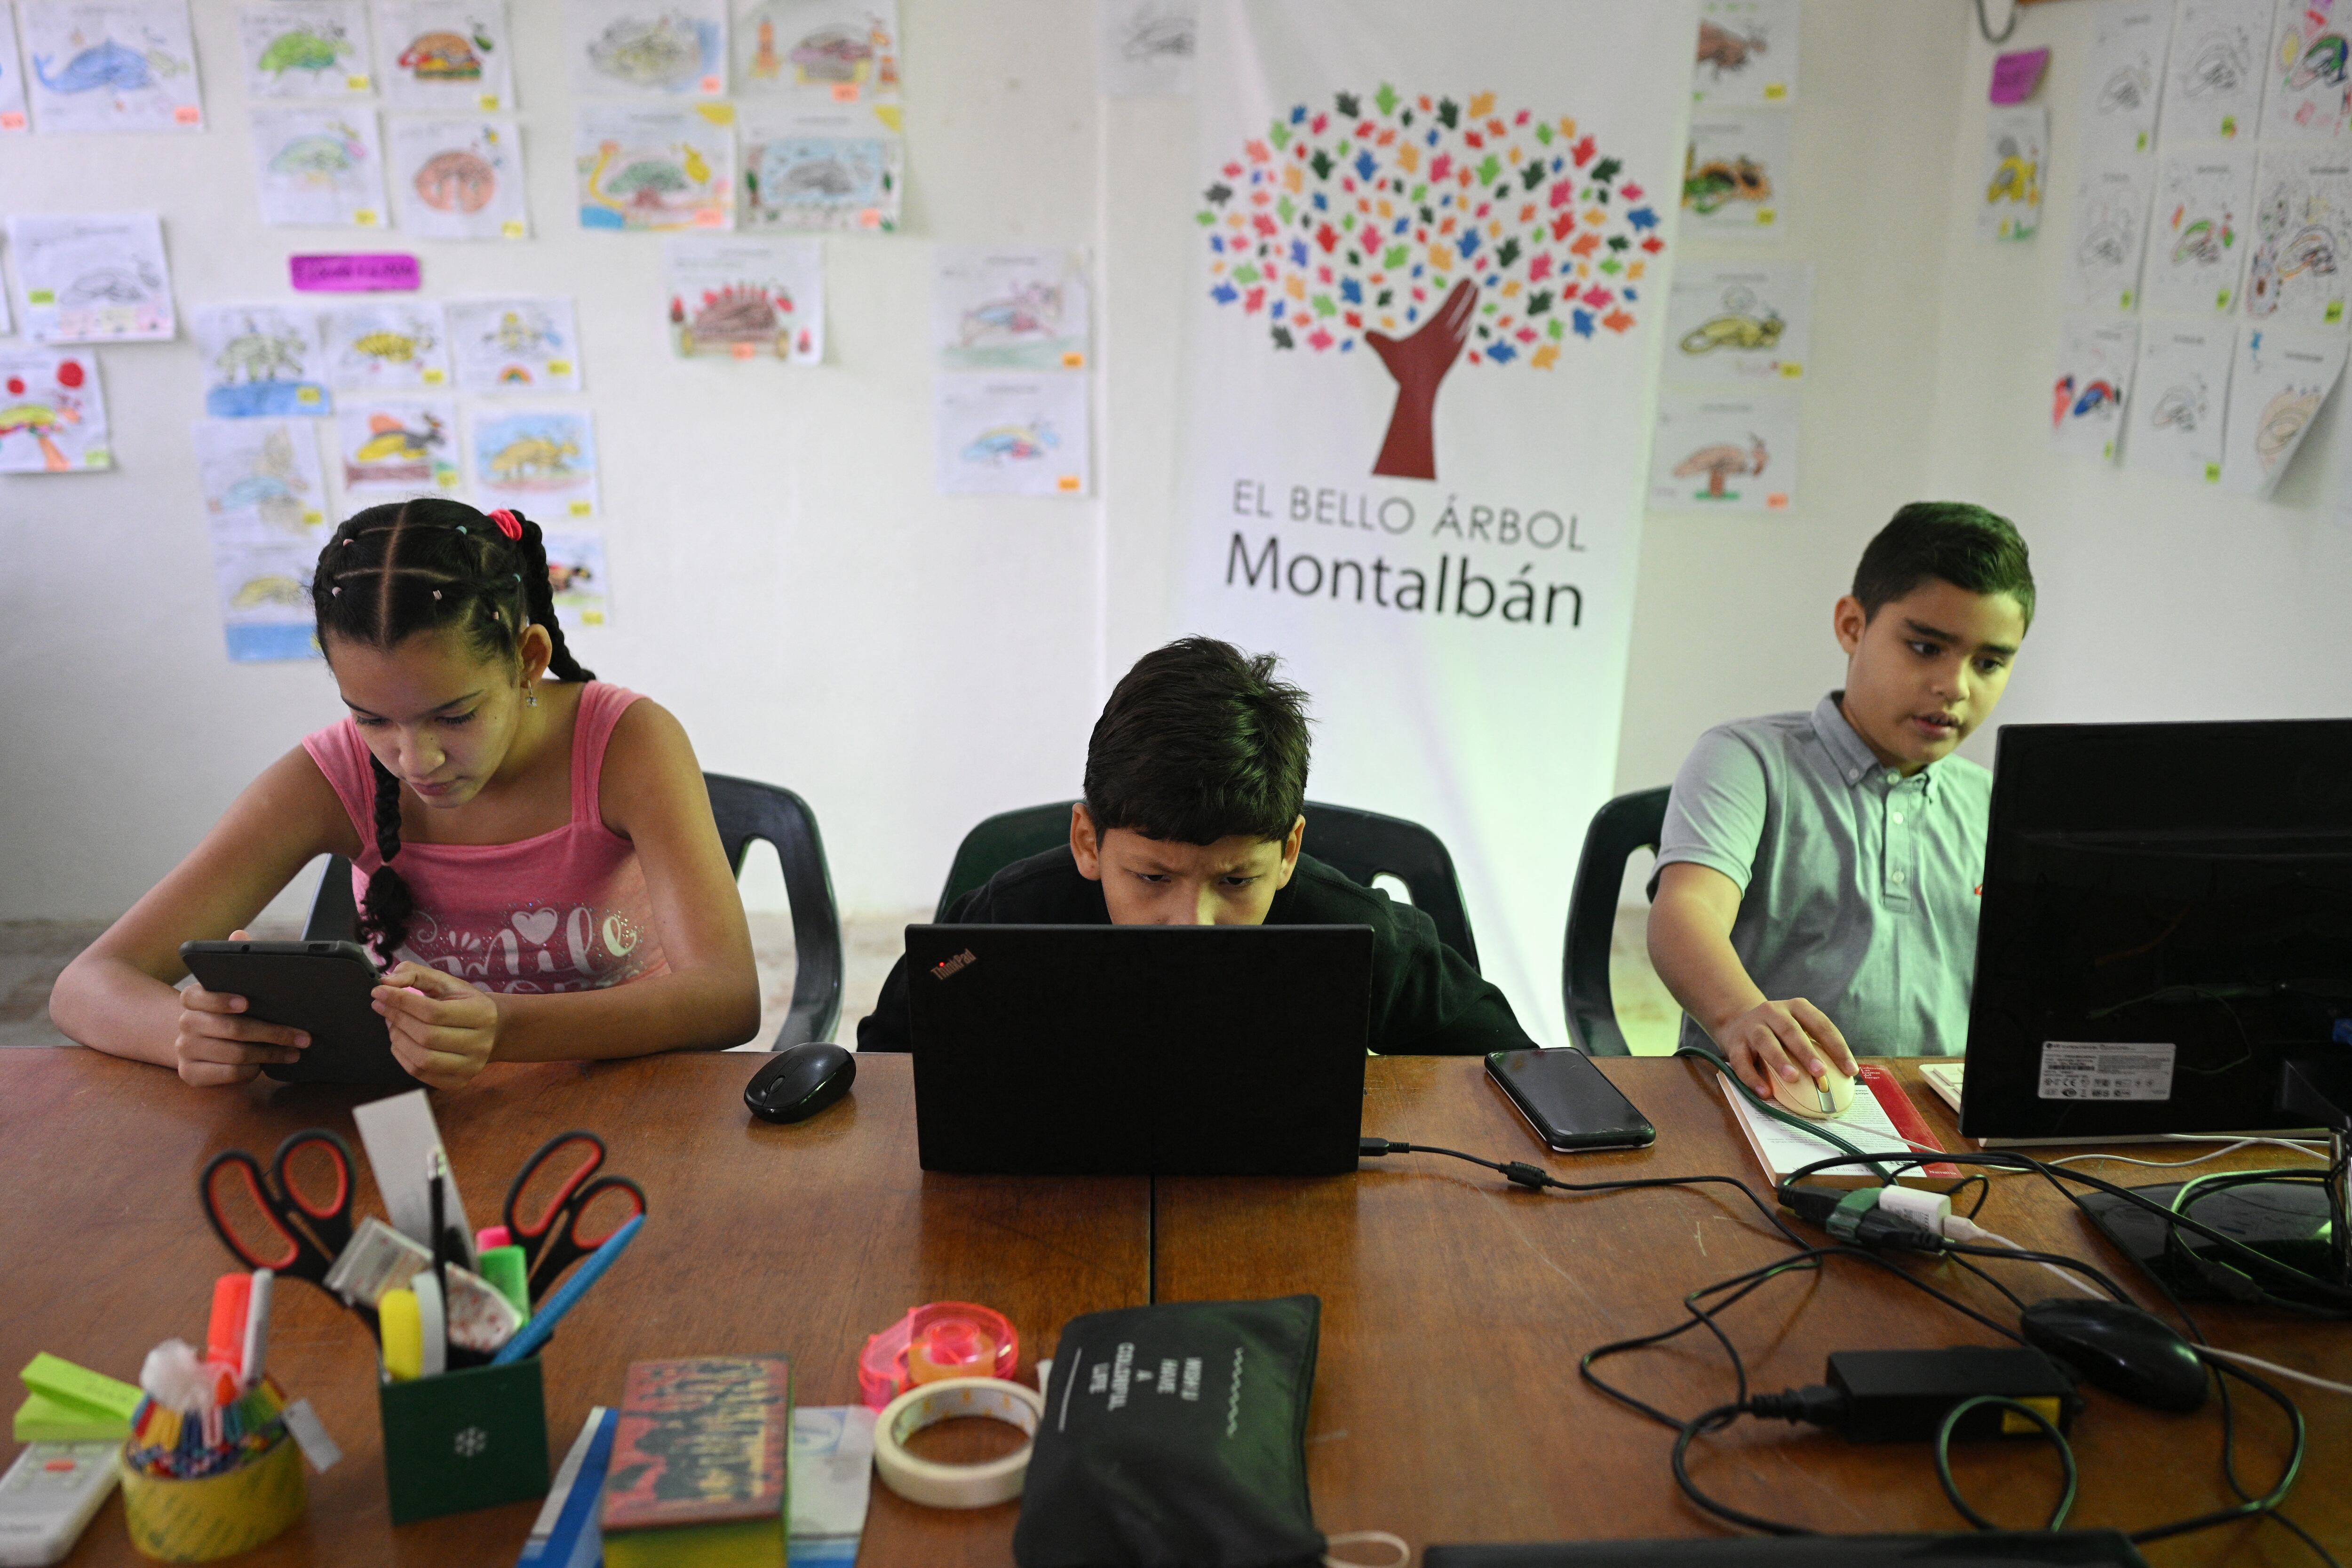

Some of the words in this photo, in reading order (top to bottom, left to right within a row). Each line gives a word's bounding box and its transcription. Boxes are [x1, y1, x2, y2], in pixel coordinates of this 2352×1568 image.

[1232, 479, 1273, 519] EL
[1289, 485, 1415, 535] BELLO
[1432, 494, 1587, 553] ÁRBOL
[1225, 531, 1583, 629] Montalbán
[930, 948, 977, 980] ThinkPad
